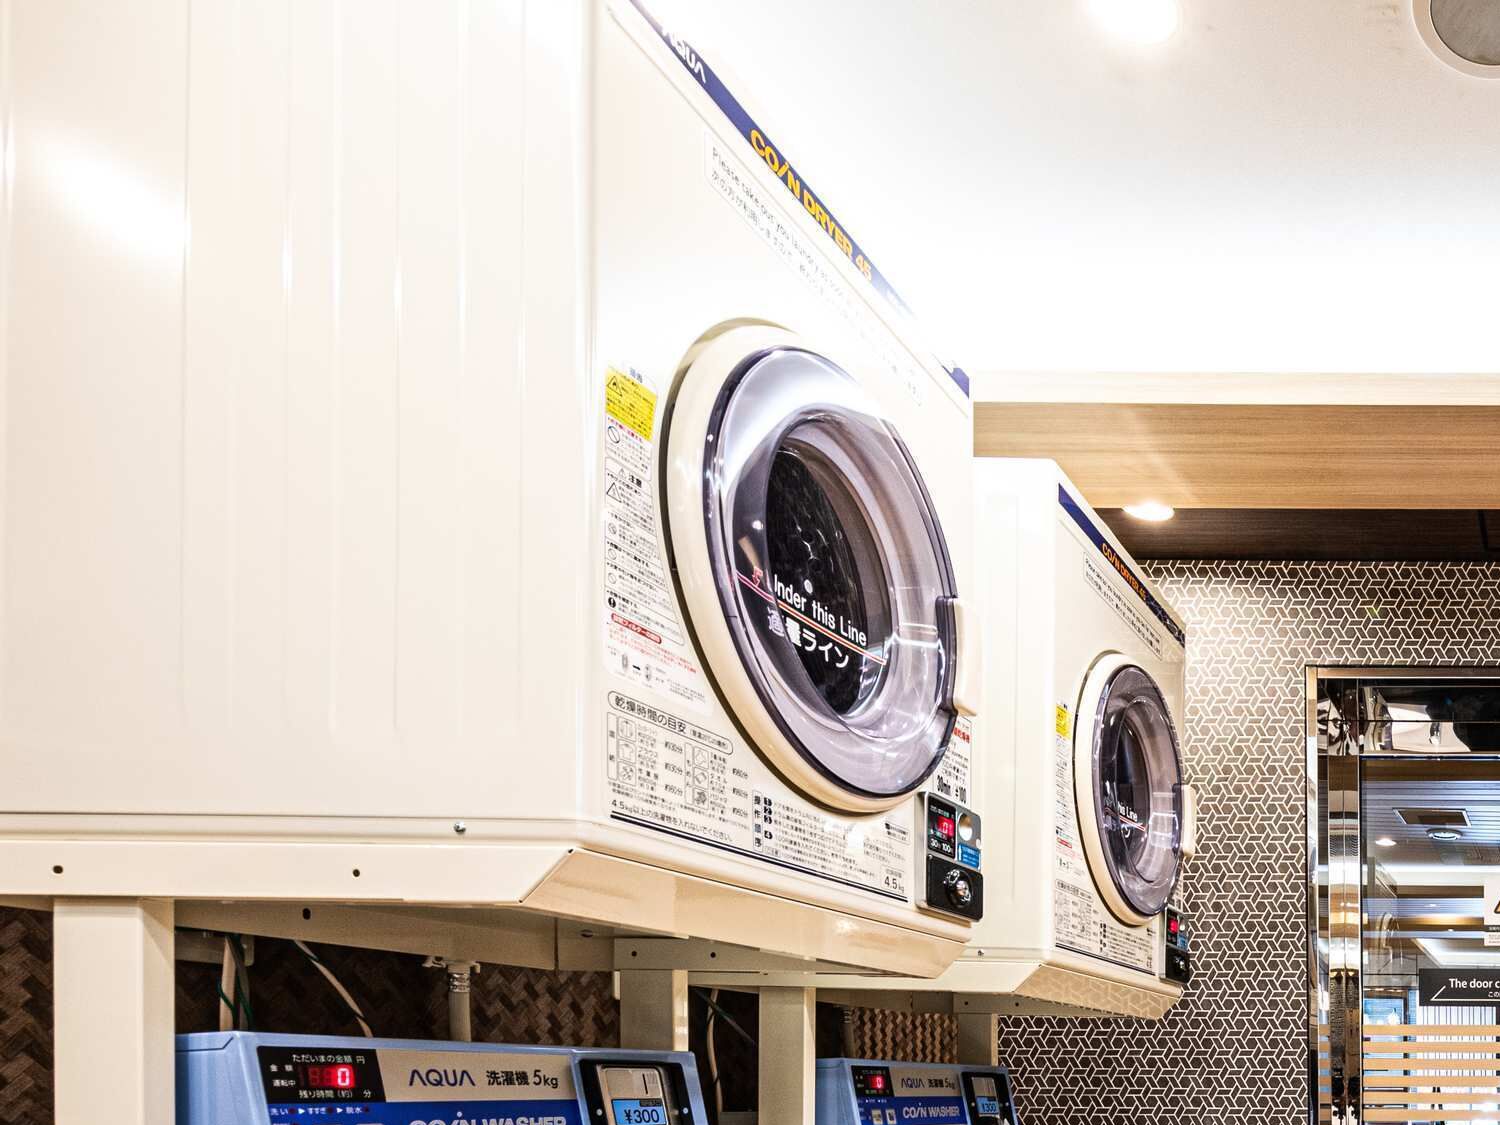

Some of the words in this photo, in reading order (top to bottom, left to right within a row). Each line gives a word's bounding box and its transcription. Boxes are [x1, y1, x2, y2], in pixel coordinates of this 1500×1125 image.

[750, 129, 801, 199] COIN
[803, 189, 854, 261] DRYER
[855, 254, 873, 280] 45
[1120, 563, 1140, 593] DRYER
[812, 600, 836, 630] this
[840, 615, 868, 647] Line
[614, 695, 688, 735] 乾燥時間の目安
[1449, 978, 1467, 989] The
[1469, 977, 1492, 989] door
[292, 1053, 353, 1063] ただいまの金額
[355, 1055, 366, 1064] 円
[337, 1067, 350, 1087] 0
[408, 1068, 476, 1087] AQUA
[485, 1069, 530, 1086] 洗濯機
[532, 1069, 559, 1089] 5kg
[901, 1077, 926, 1089] AQUA
[362, 1089, 372, 1098] 分
[623, 1108, 660, 1124] ¥300
[902, 1102, 927, 1119] COIN
[927, 1105, 960, 1118] WASHER
